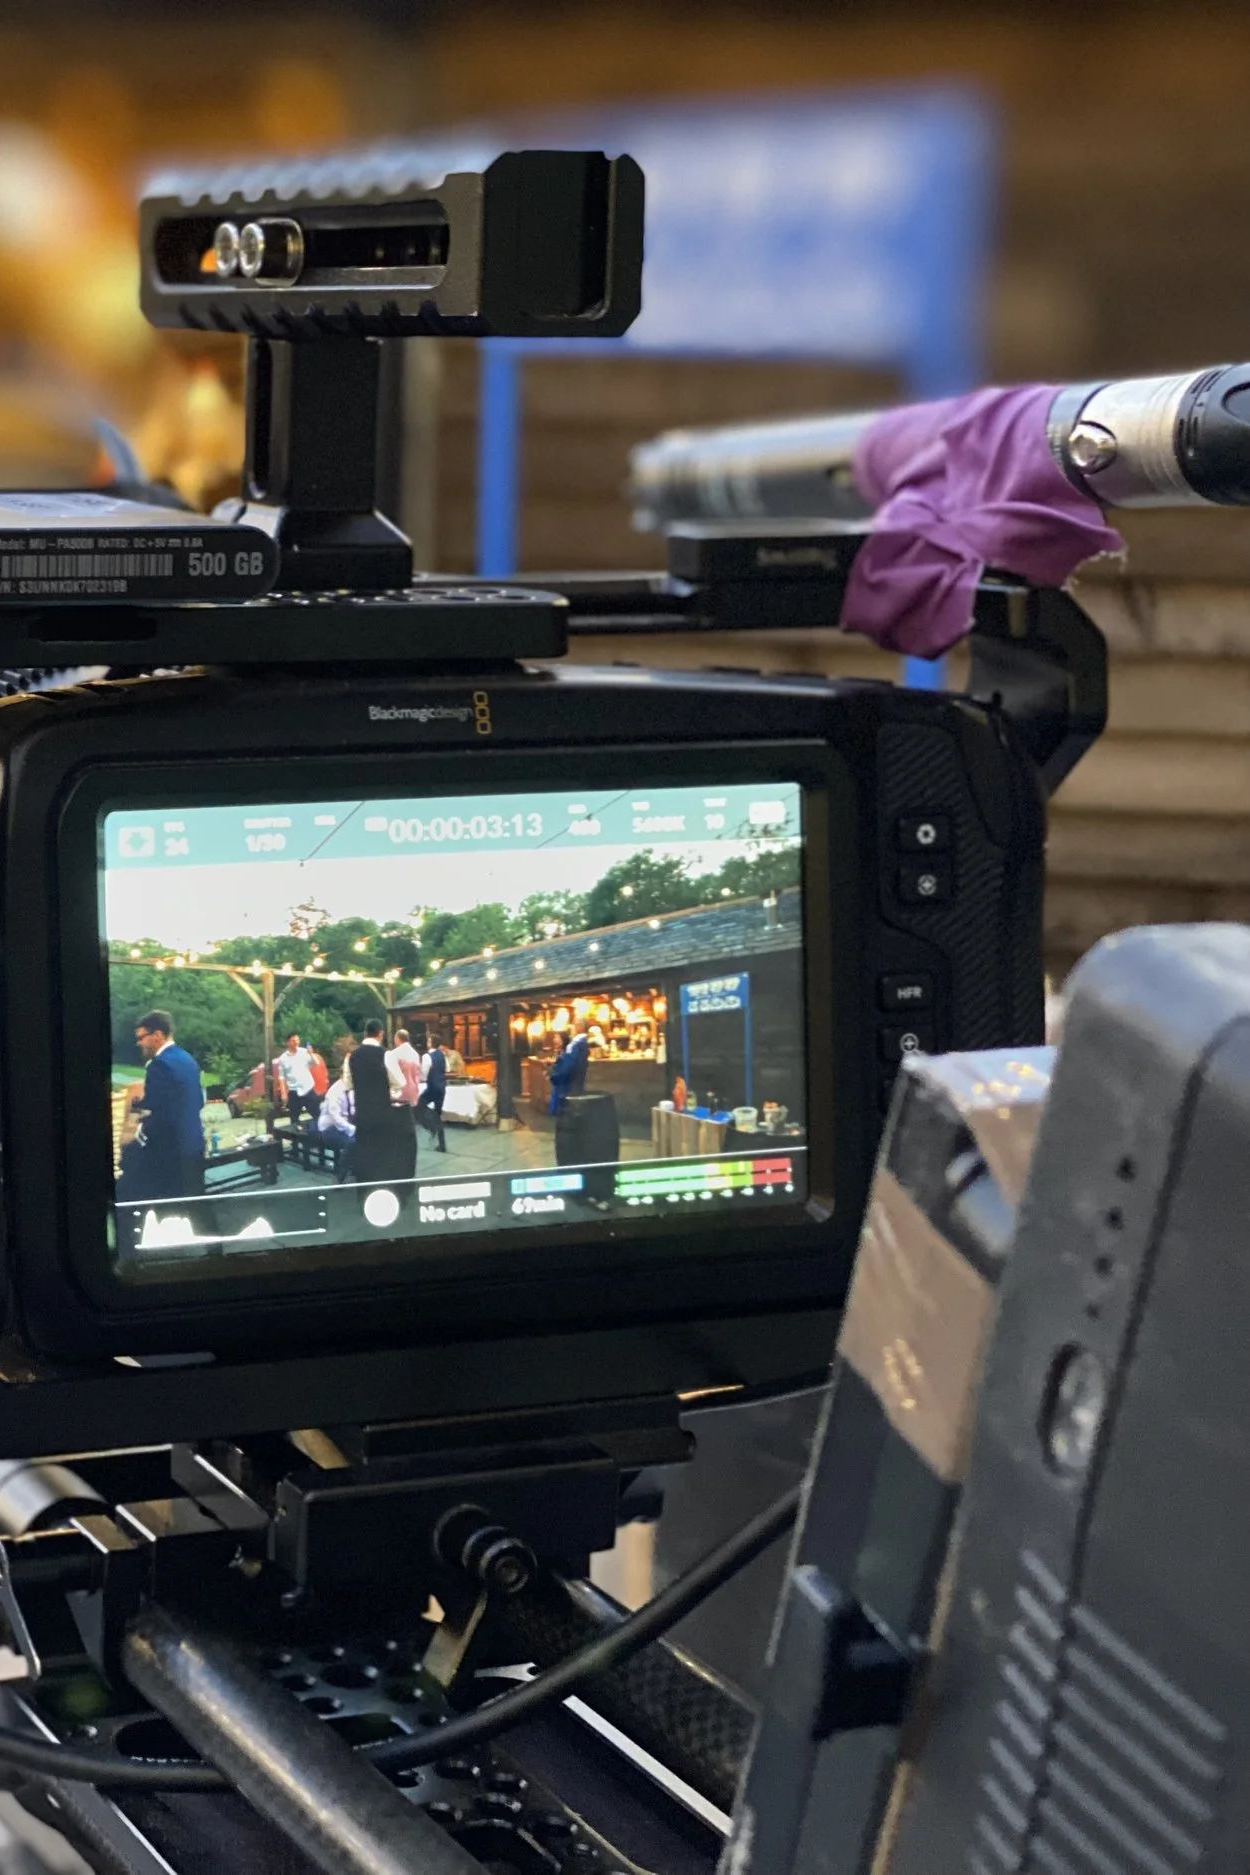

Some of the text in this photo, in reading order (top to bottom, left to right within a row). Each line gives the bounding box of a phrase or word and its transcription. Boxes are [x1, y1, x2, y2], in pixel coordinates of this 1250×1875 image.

[188, 551, 264, 576] 500 GB
[388, 812, 543, 844] 00:00:03:13
[897, 986, 922, 1000] HFR
[419, 1200, 485, 1223] No card
